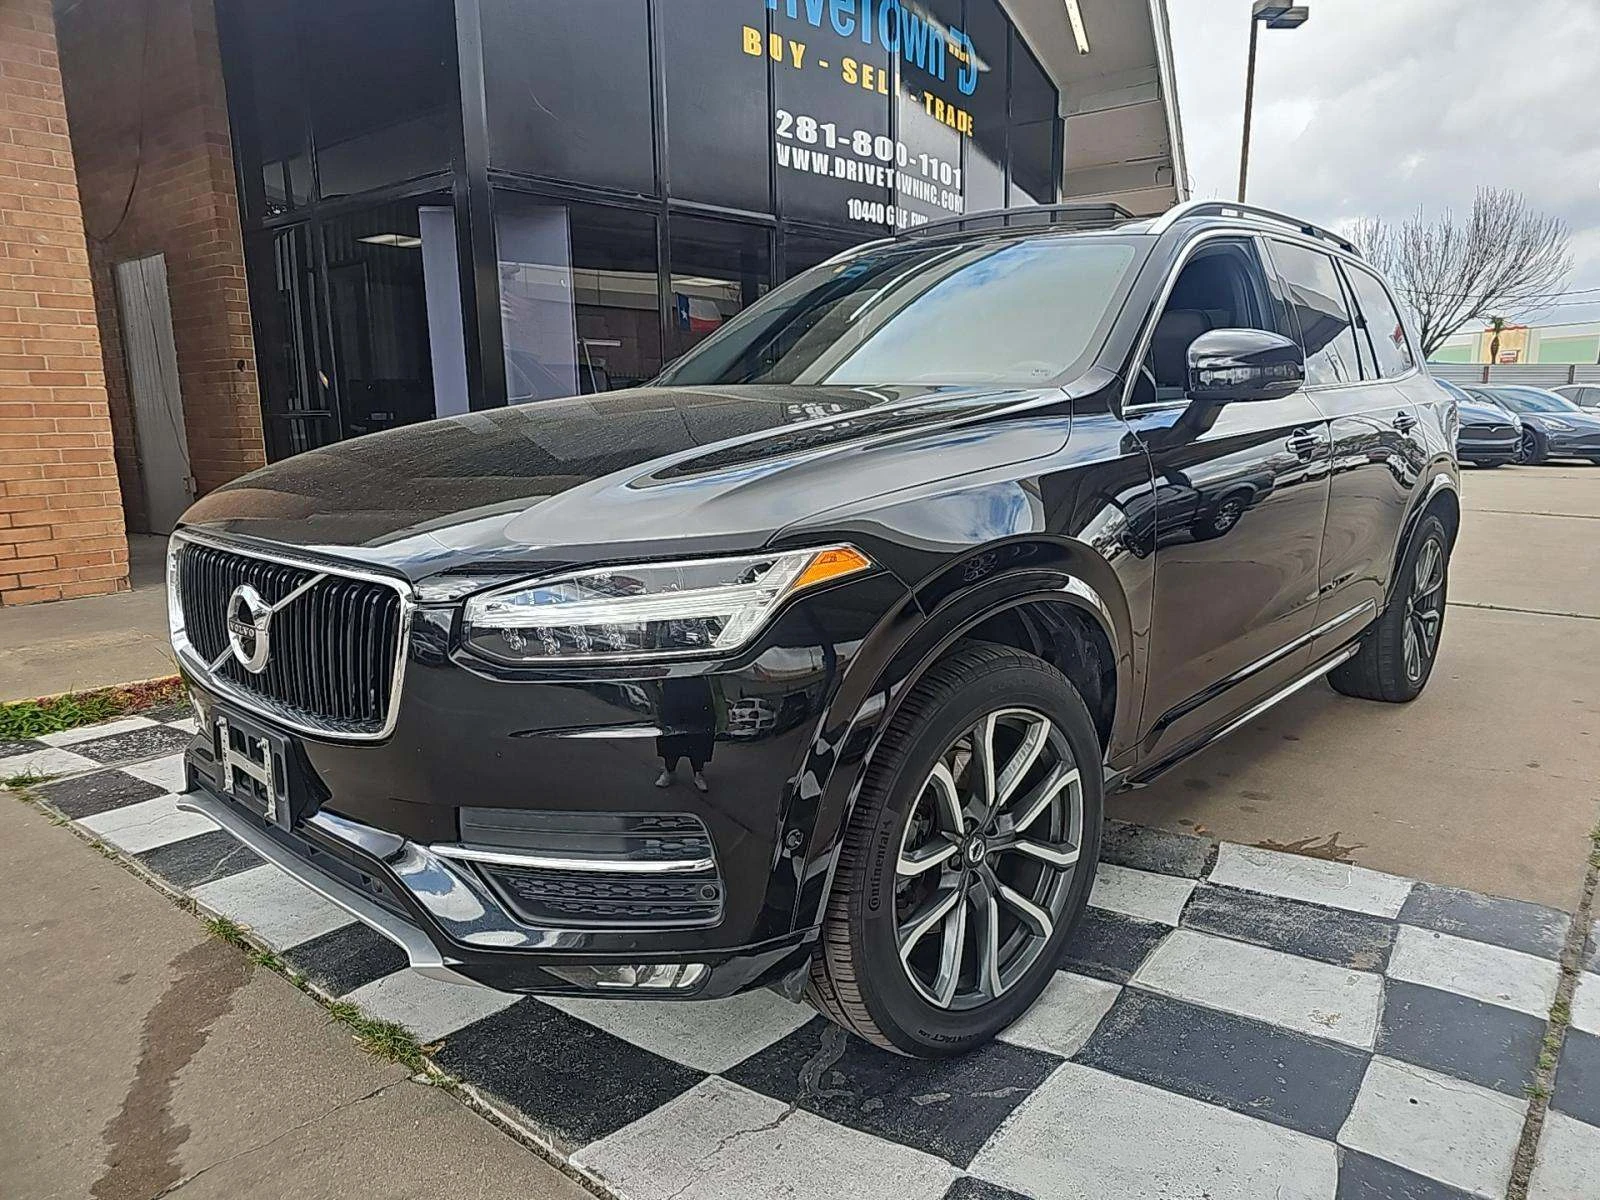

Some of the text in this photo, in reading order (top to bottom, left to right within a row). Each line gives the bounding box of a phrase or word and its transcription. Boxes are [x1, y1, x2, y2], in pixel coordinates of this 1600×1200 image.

[742, 25, 806, 69] BUY
[923, 90, 974, 137] TRADE
[776, 109, 962, 189] 281-800-1101
[847, 198, 885, 224] 10440
[230, 621, 255, 638] VOLVO
[868, 831, 891, 911] Continental
